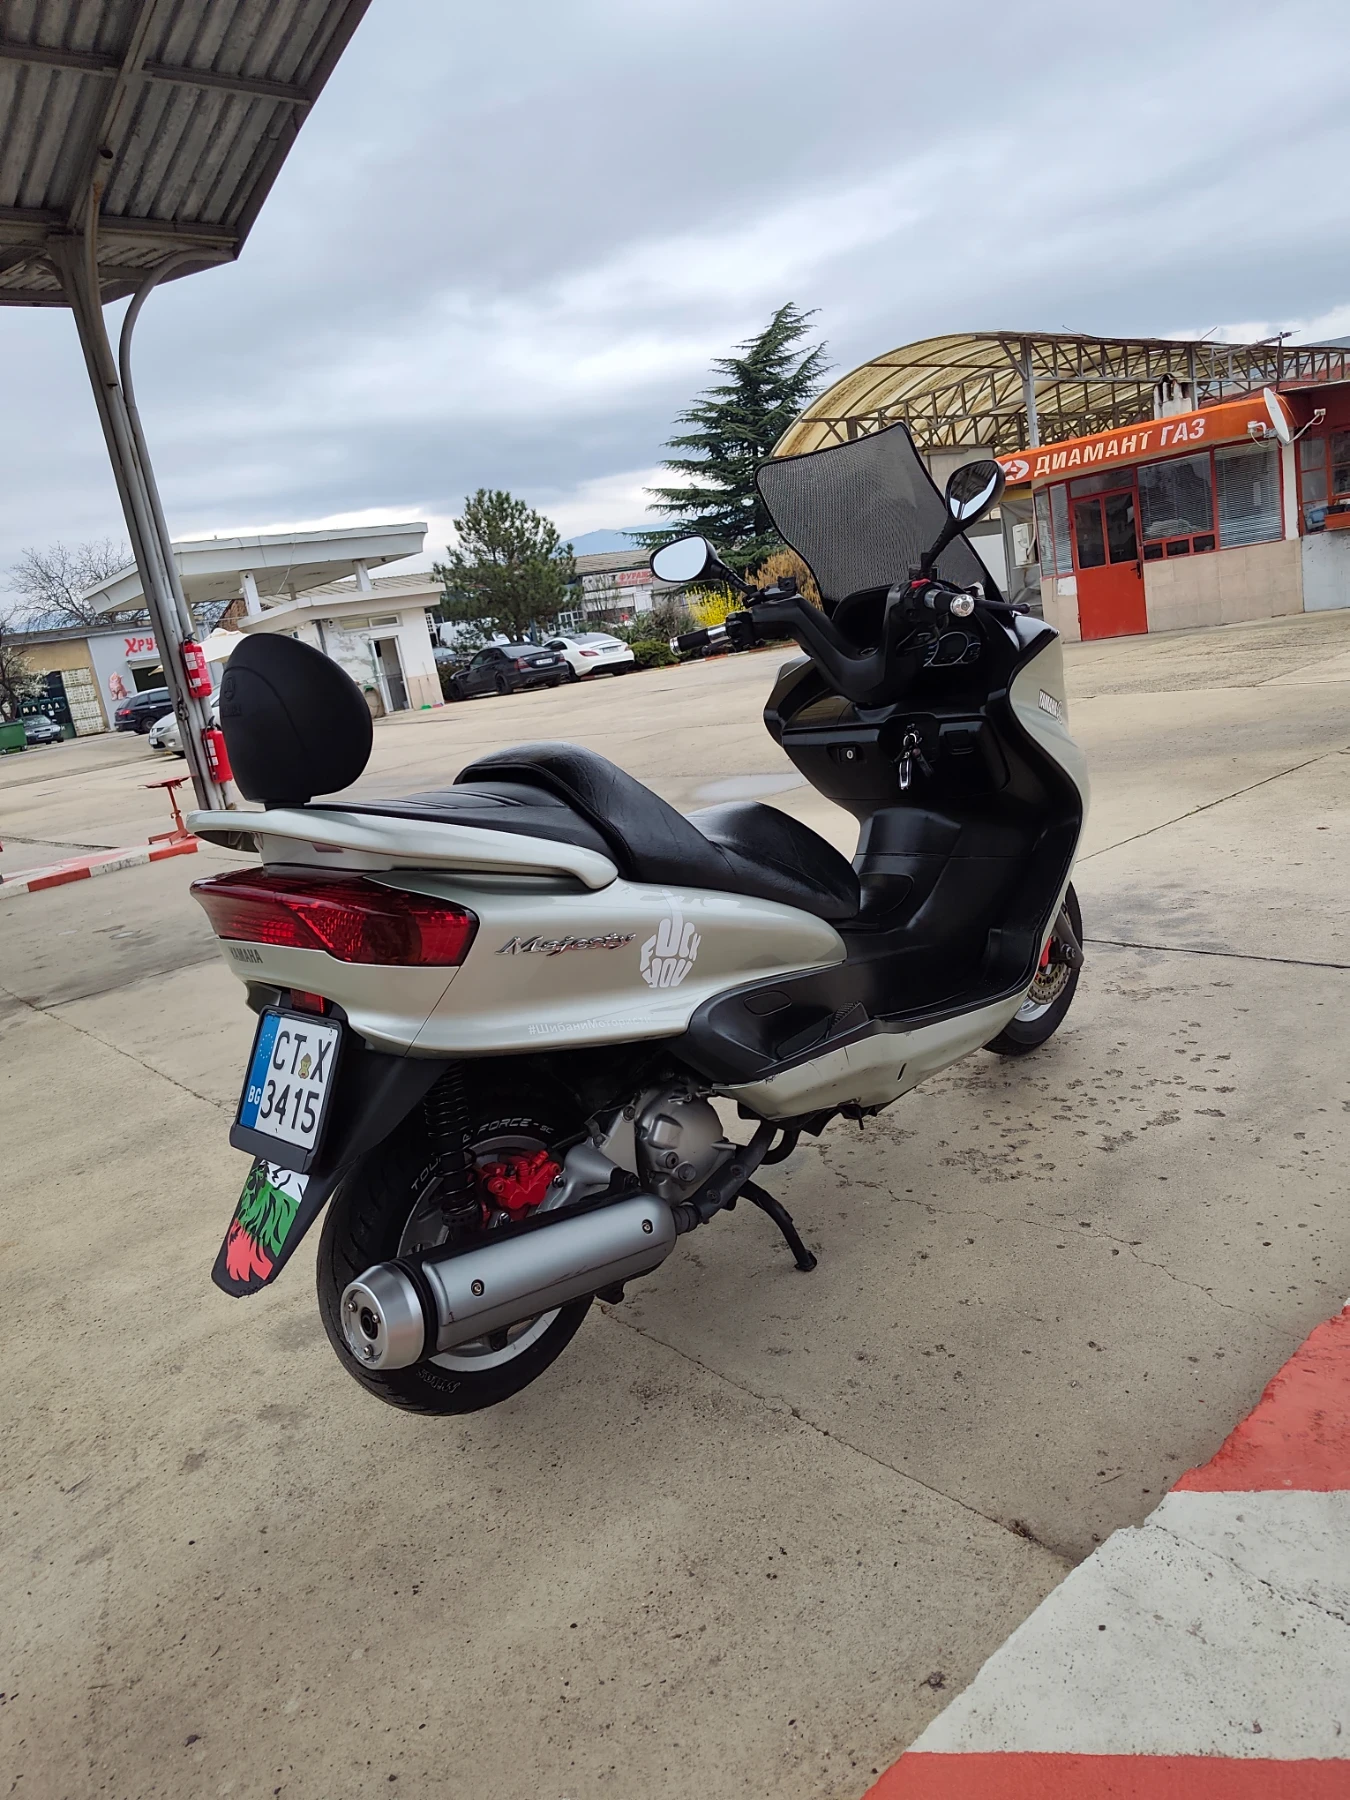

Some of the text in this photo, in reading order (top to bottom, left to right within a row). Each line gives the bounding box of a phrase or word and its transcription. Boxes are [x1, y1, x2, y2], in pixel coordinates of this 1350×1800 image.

[1033, 418, 1206, 478] ДИАМАНТ ГАЗ
[228, 946, 264, 964] YAMAHA
[496, 932, 637, 957] Majesty
[247, 1085, 262, 1105] BG
[260, 1079, 320, 1134] 3415
